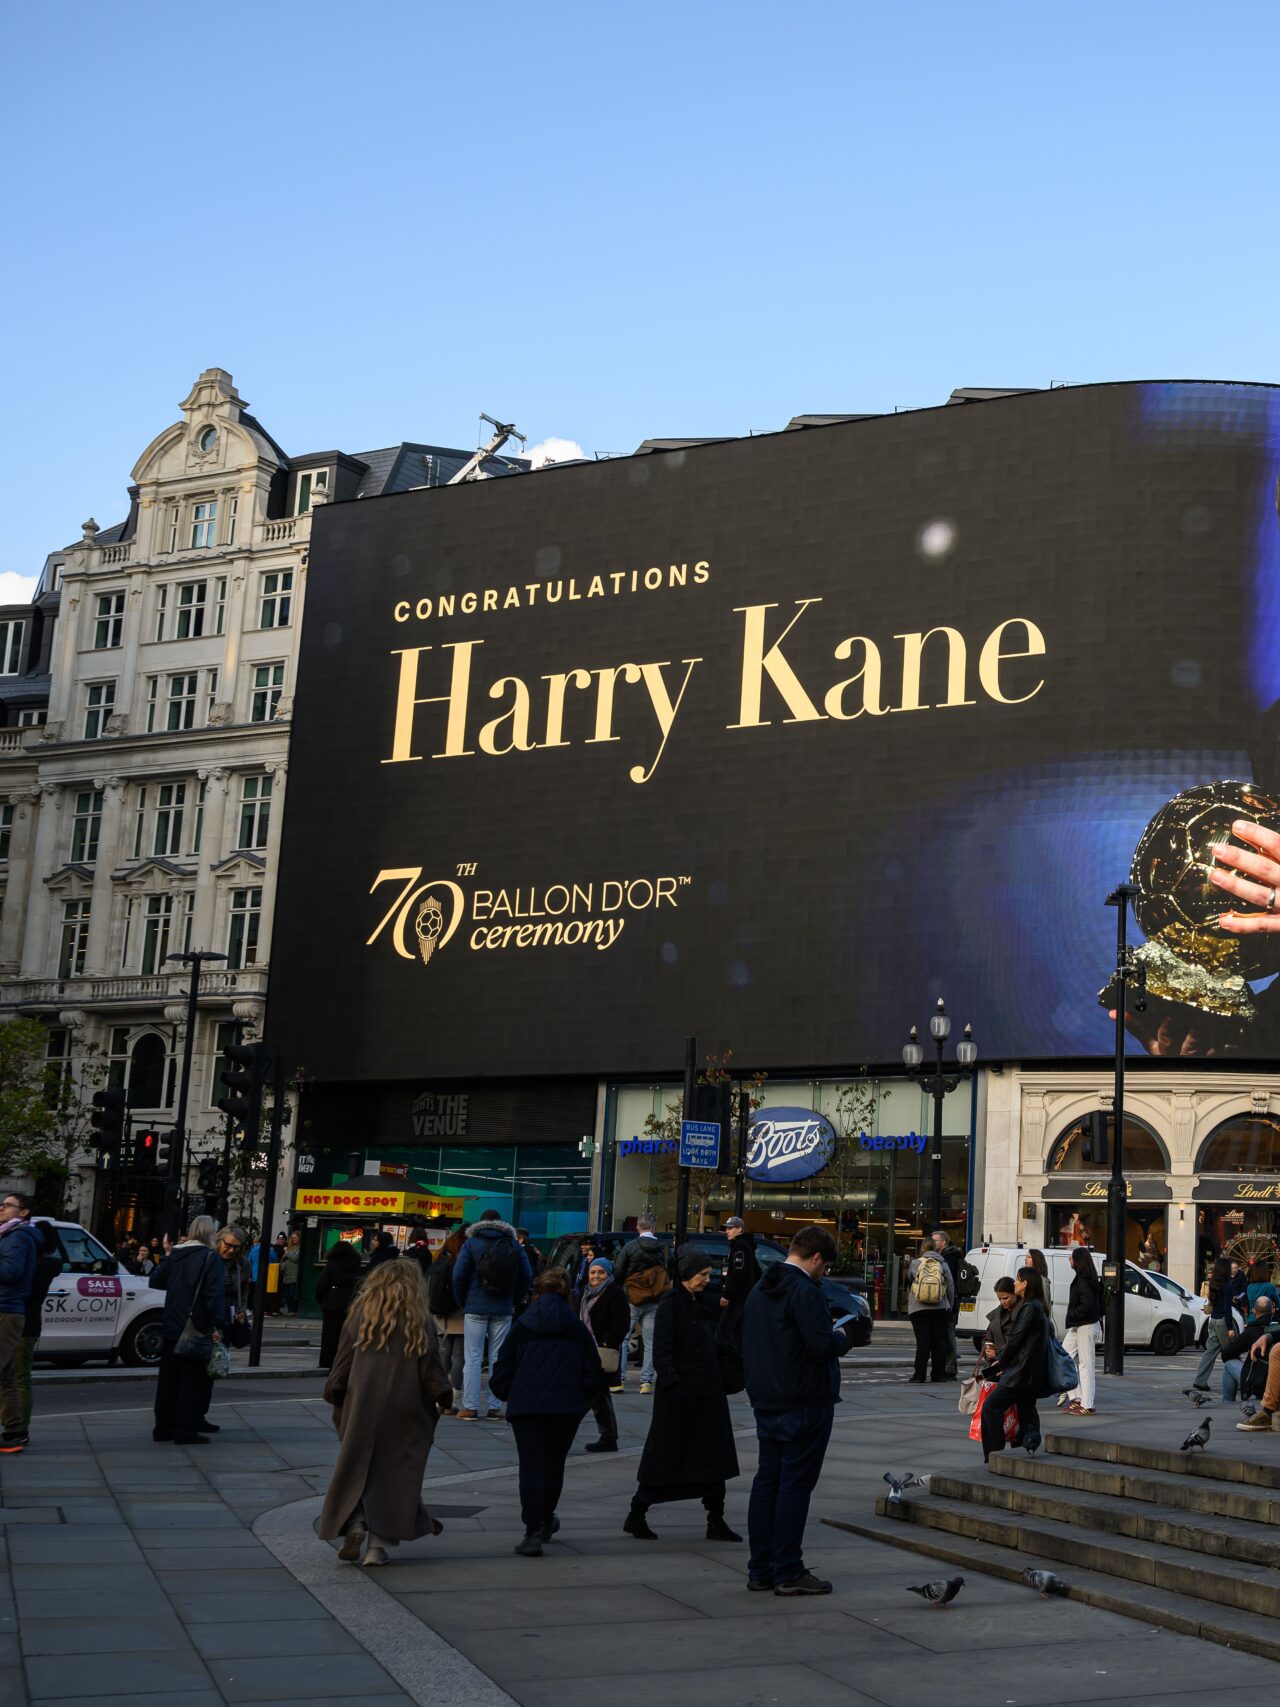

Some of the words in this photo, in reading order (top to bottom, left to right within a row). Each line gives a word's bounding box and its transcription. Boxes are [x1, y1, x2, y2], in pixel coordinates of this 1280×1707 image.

[394, 561, 710, 623] CONGRATULATIONS
[380, 640, 703, 784] Harry
[726, 598, 1046, 729] Kane
[472, 883, 593, 920] BALLON
[470, 918, 625, 951] ceremony
[436, 1094, 469, 1116] THE
[412, 1115, 468, 1136] VENUE
[686, 1123, 699, 1132] BUS
[700, 1124, 716, 1133] LANE
[746, 1119, 820, 1169] Boots
[860, 1131, 928, 1155] beauty
[303, 1195, 330, 1205] HOT
[333, 1195, 361, 1206] DOG
[363, 1197, 398, 1206] SPOT
[1233, 1183, 1275, 1198] Lindt
[88, 1280, 116, 1288] SALE
